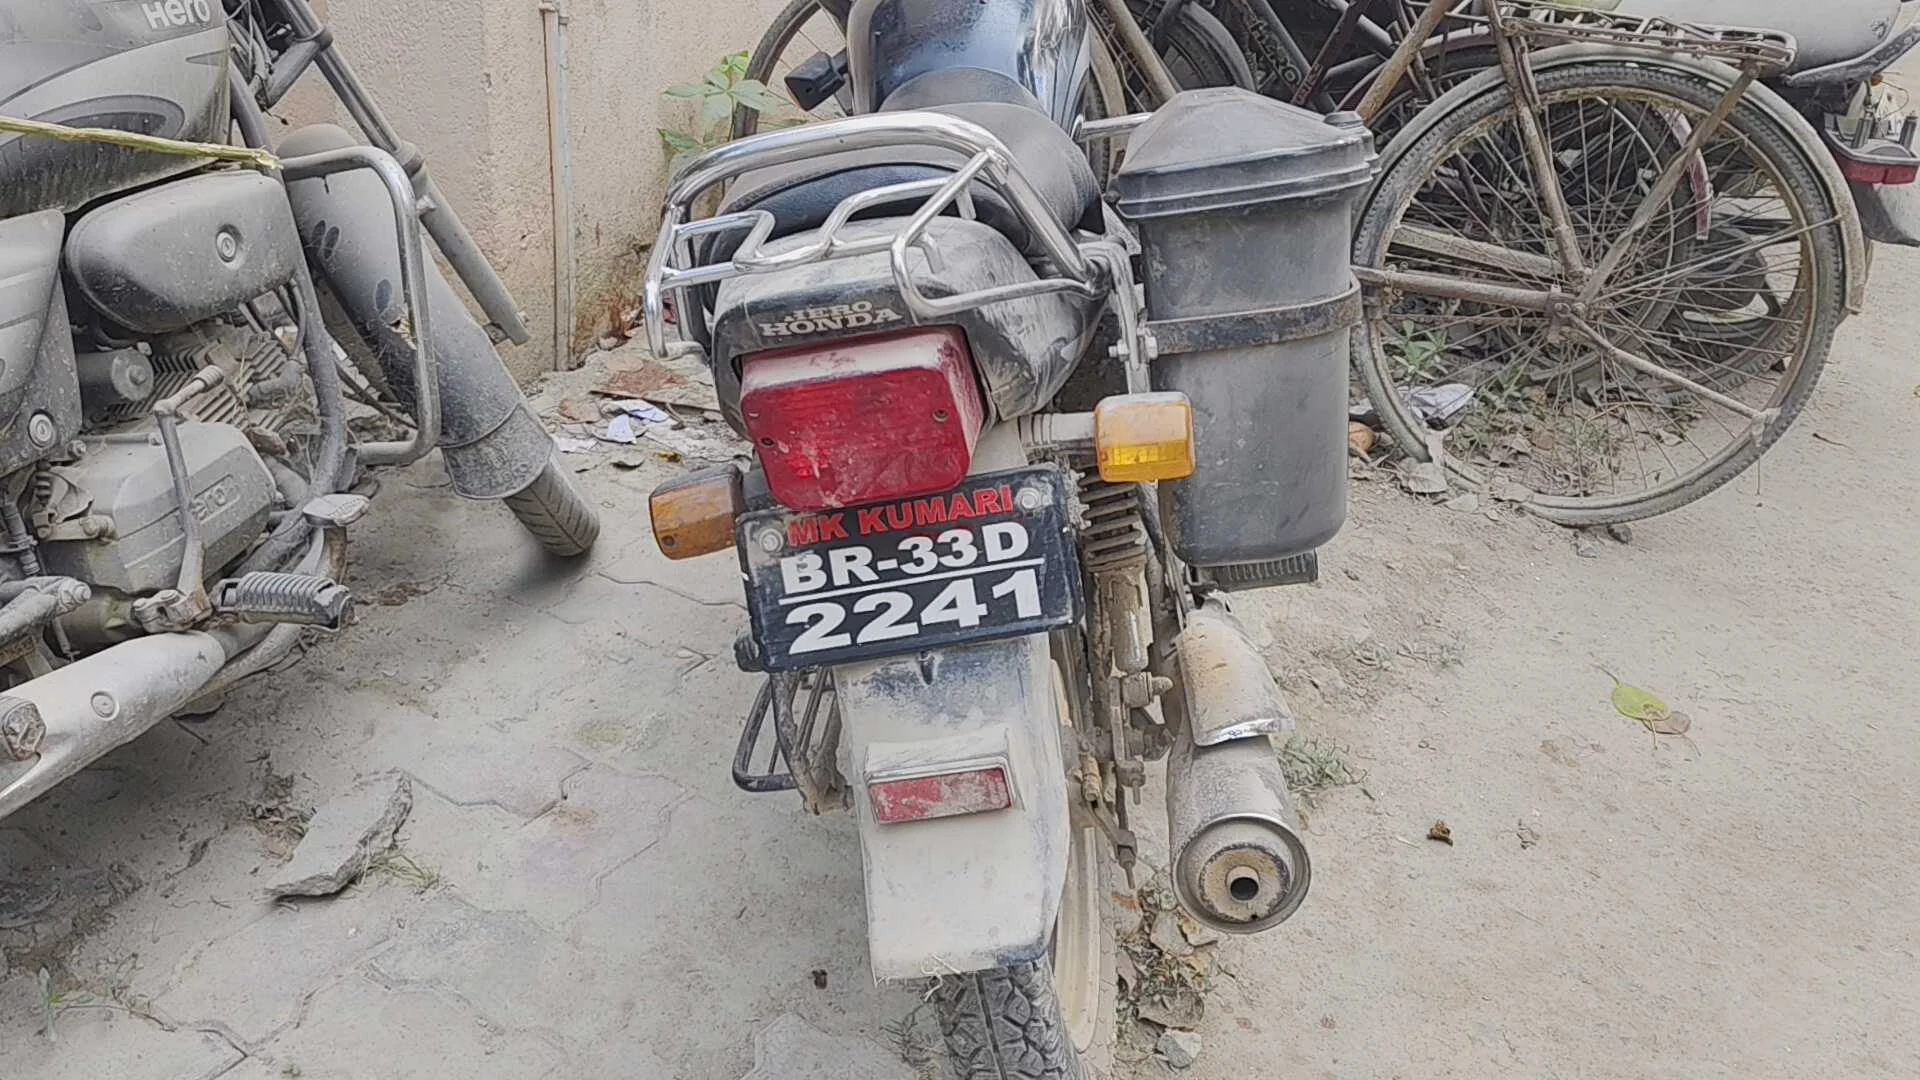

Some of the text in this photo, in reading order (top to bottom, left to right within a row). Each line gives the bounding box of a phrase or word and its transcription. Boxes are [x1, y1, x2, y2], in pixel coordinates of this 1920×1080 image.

[141, 0, 211, 29] Hero
[759, 308, 903, 336] HONDA
[785, 485, 1014, 547] MK KUMARI
[780, 521, 1029, 595] BR-33D
[785, 569, 1043, 655] 2241
